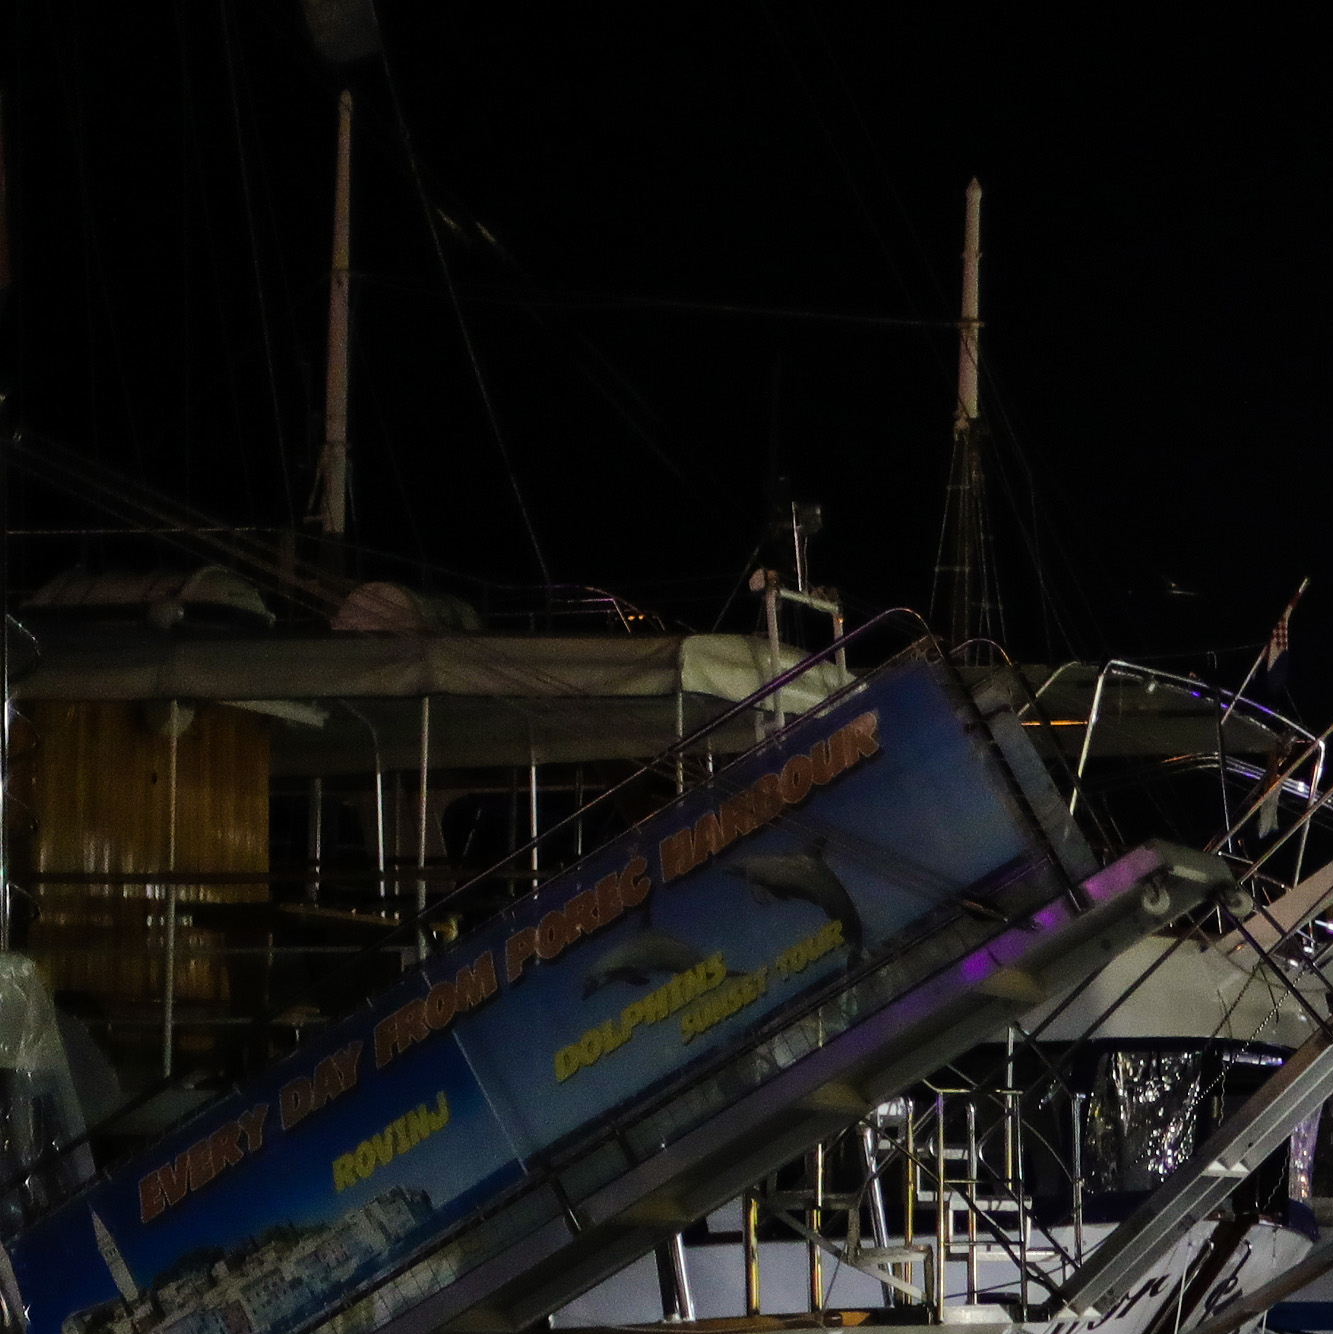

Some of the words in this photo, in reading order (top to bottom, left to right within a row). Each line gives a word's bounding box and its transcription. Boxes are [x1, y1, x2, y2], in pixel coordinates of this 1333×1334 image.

[138, 1101, 270, 1223] EVERY
[280, 1039, 364, 1133] DAY
[375, 952, 497, 1069] FROM
[506, 846, 651, 981] POREČ
[659, 710, 880, 883] HARBOUR
[554, 949, 728, 1083] DOLPHINS
[332, 1091, 450, 1195] ROVINJ
